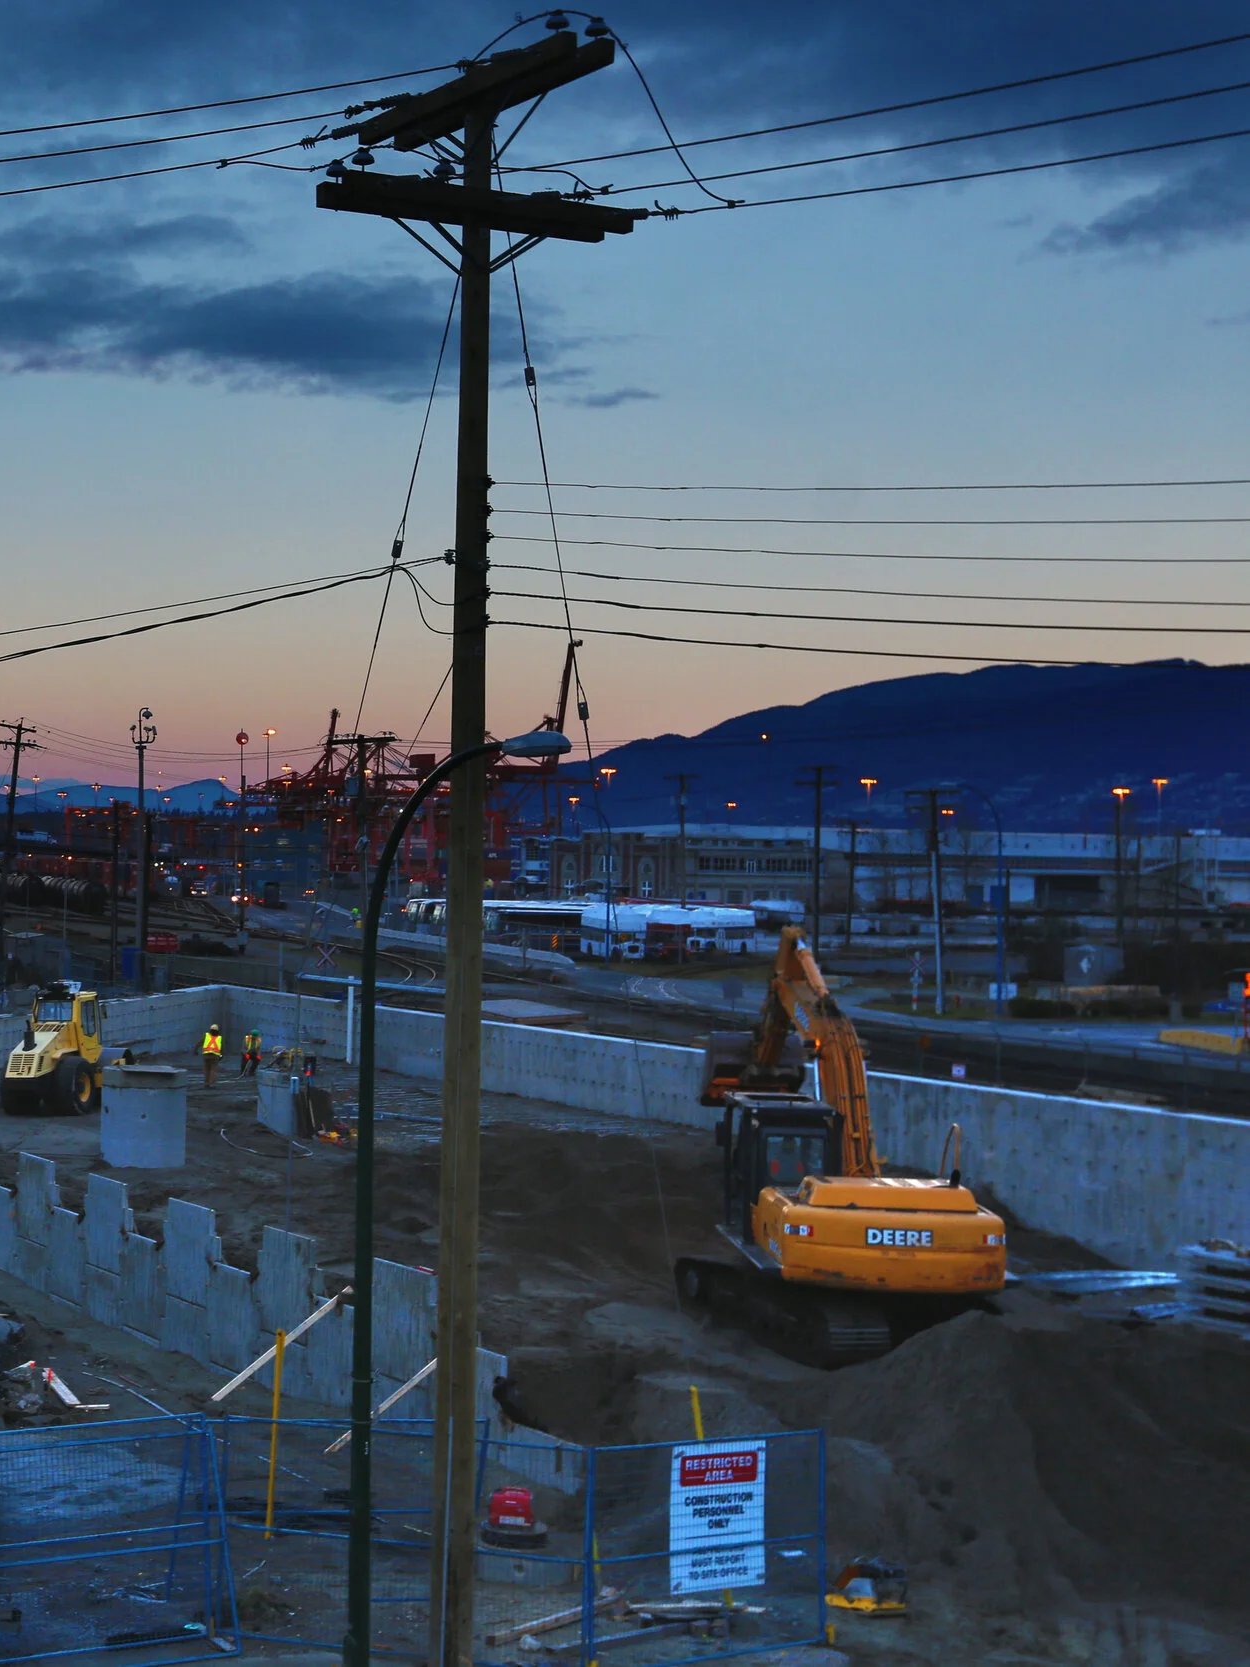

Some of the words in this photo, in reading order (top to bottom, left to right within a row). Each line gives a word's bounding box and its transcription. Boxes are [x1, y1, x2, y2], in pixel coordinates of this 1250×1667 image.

[867, 1228, 932, 1247] DEERE
[685, 1456, 753, 1470] RESTRICTED
[704, 1470, 734, 1482] AREA
[685, 1493, 753, 1507] CONSTRUCTION
[693, 1506, 745, 1519] PERSONNEL
[707, 1519, 730, 1529] ONLY
[691, 1557, 712, 1568] MUST
[715, 1554, 745, 1565] REPORT
[689, 1571, 699, 1581] TO
[701, 1569, 718, 1579] SITE
[720, 1566, 748, 1578] OFFICE
